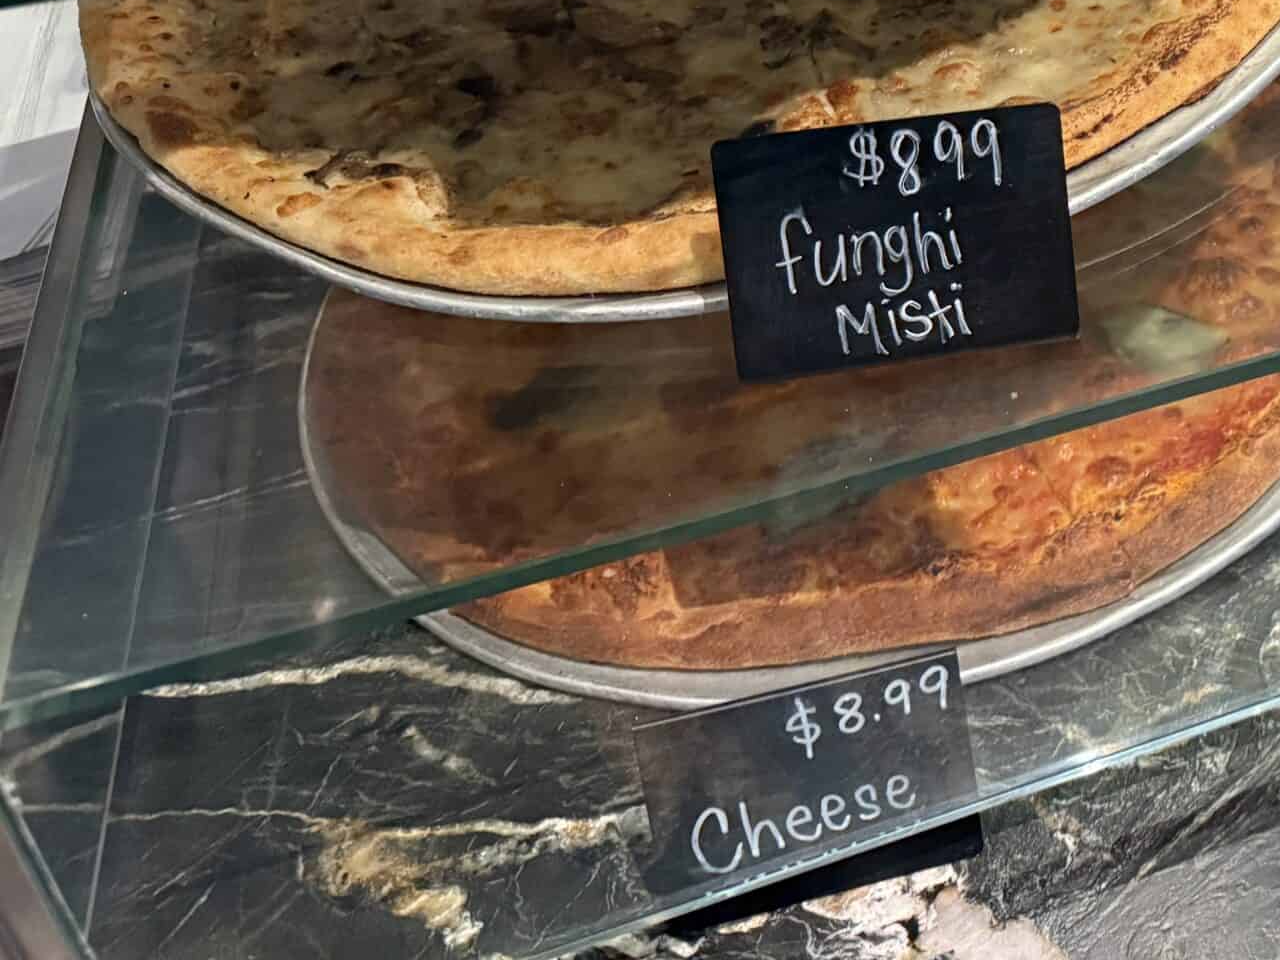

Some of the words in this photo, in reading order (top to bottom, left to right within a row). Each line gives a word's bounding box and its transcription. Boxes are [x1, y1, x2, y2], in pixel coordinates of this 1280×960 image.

[836, 283, 973, 356] Misti
[785, 665, 949, 759] $8.99
[691, 774, 917, 873] Cheese
